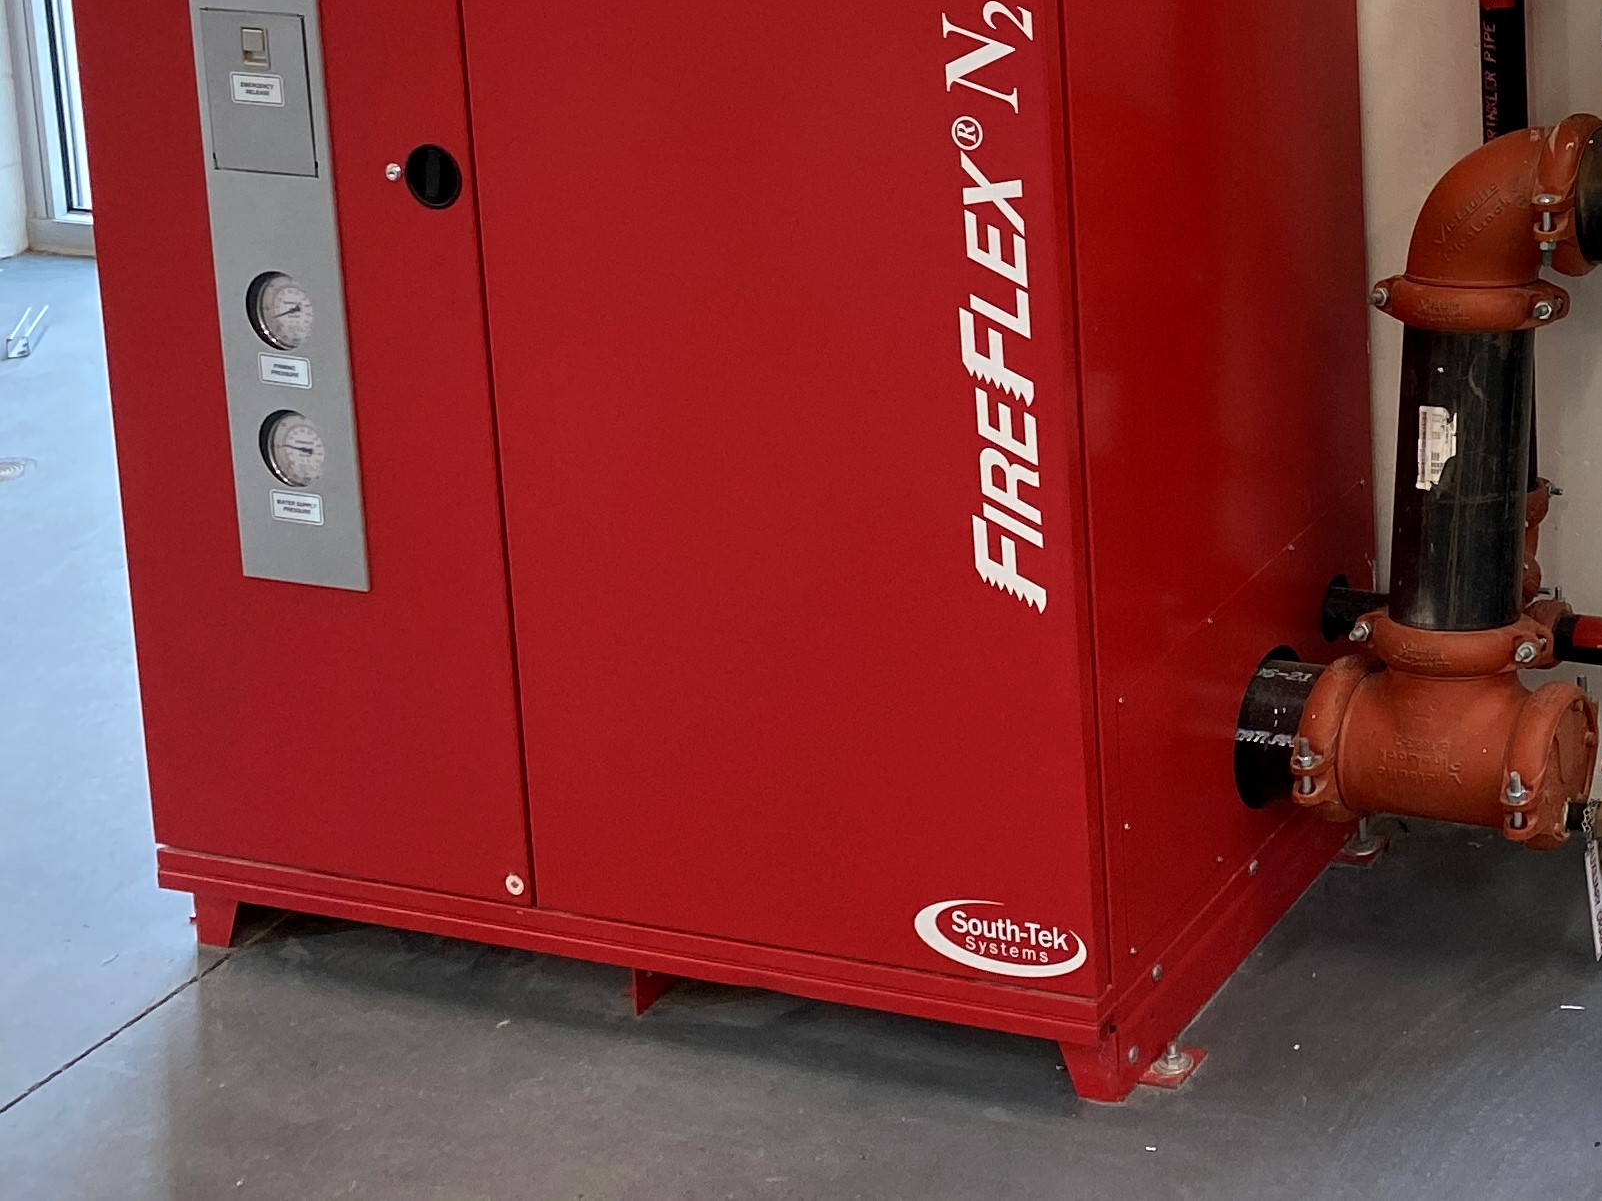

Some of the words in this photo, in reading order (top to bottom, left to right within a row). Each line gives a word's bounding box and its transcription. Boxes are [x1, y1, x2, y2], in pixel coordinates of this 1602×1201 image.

[1482, 21, 1497, 63] PIPE
[1484, 70, 1499, 142] RINKLER
[951, 909, 1069, 951] South-Tek
[965, 935, 1049, 963] Systems
